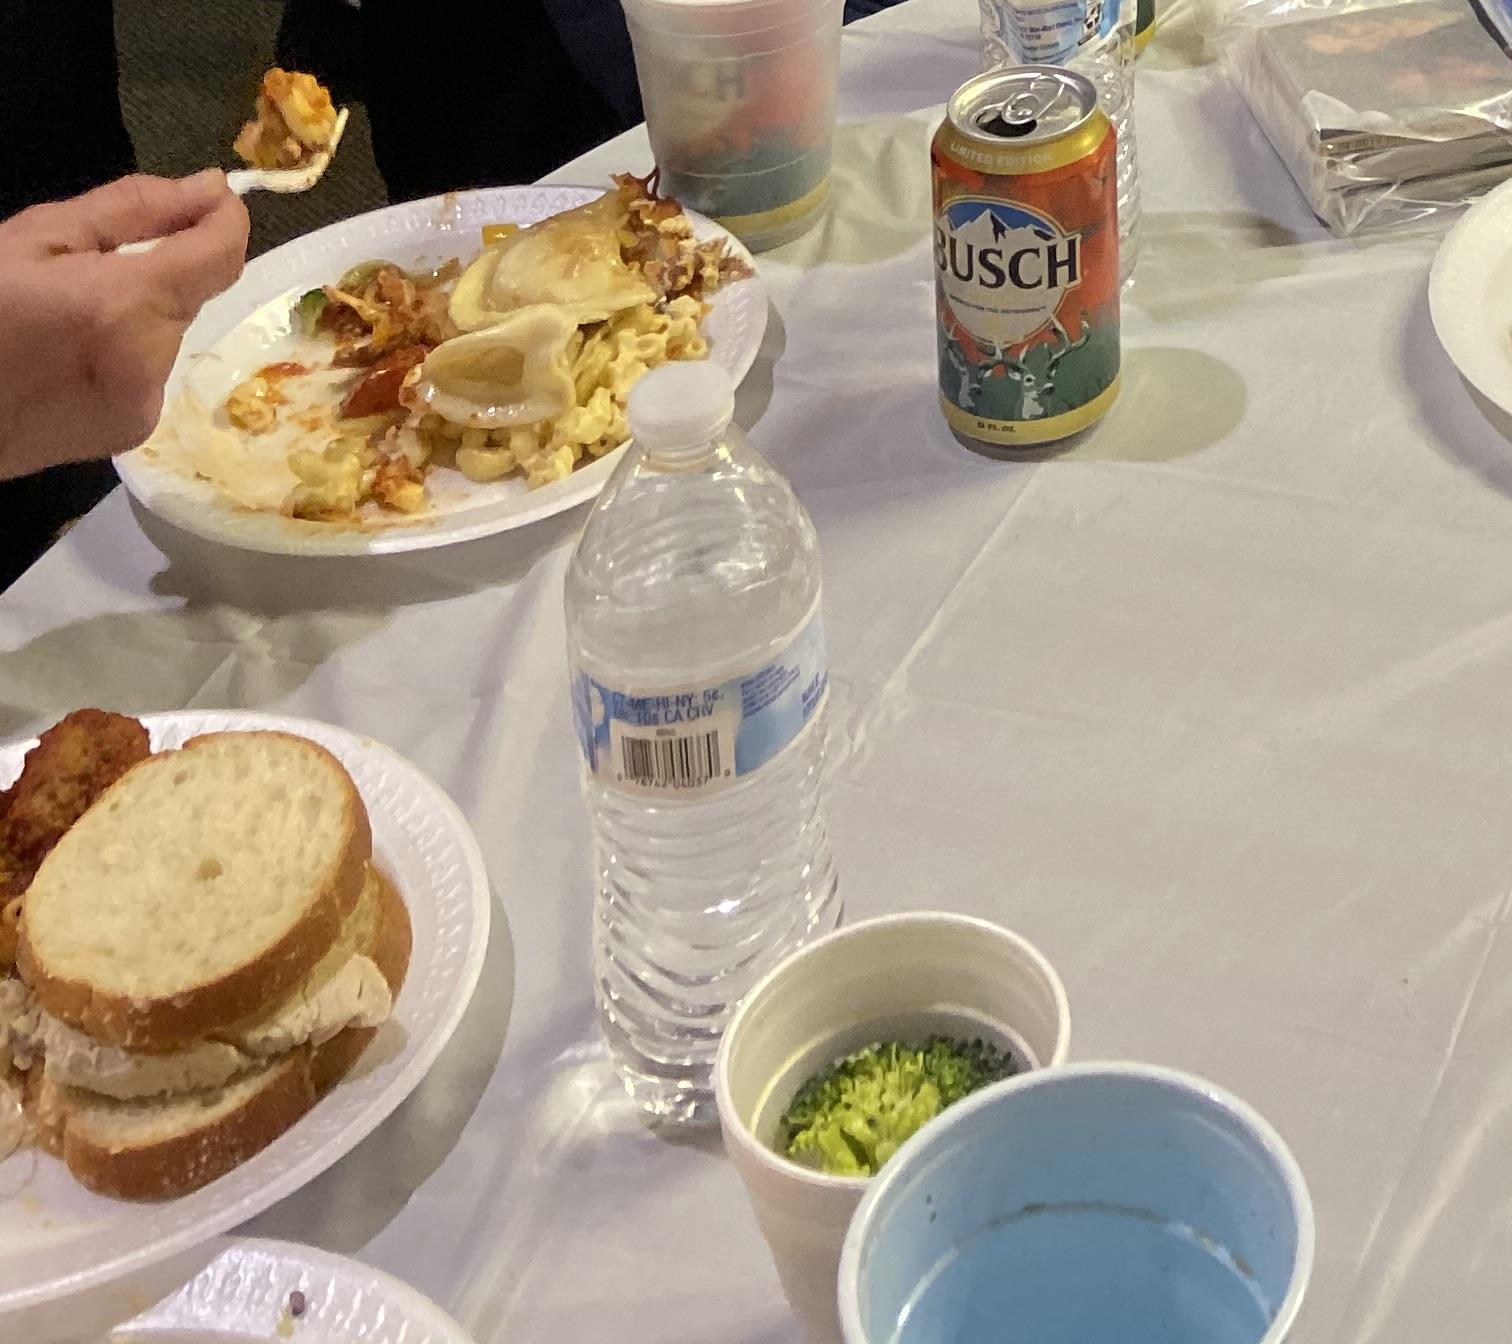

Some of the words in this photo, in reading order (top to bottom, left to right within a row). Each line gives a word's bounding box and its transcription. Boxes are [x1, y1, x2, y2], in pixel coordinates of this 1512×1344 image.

[950, 142, 993, 165] LIMITED
[997, 155, 1052, 167] EDITION
[936, 225, 1078, 290] BUSCH
